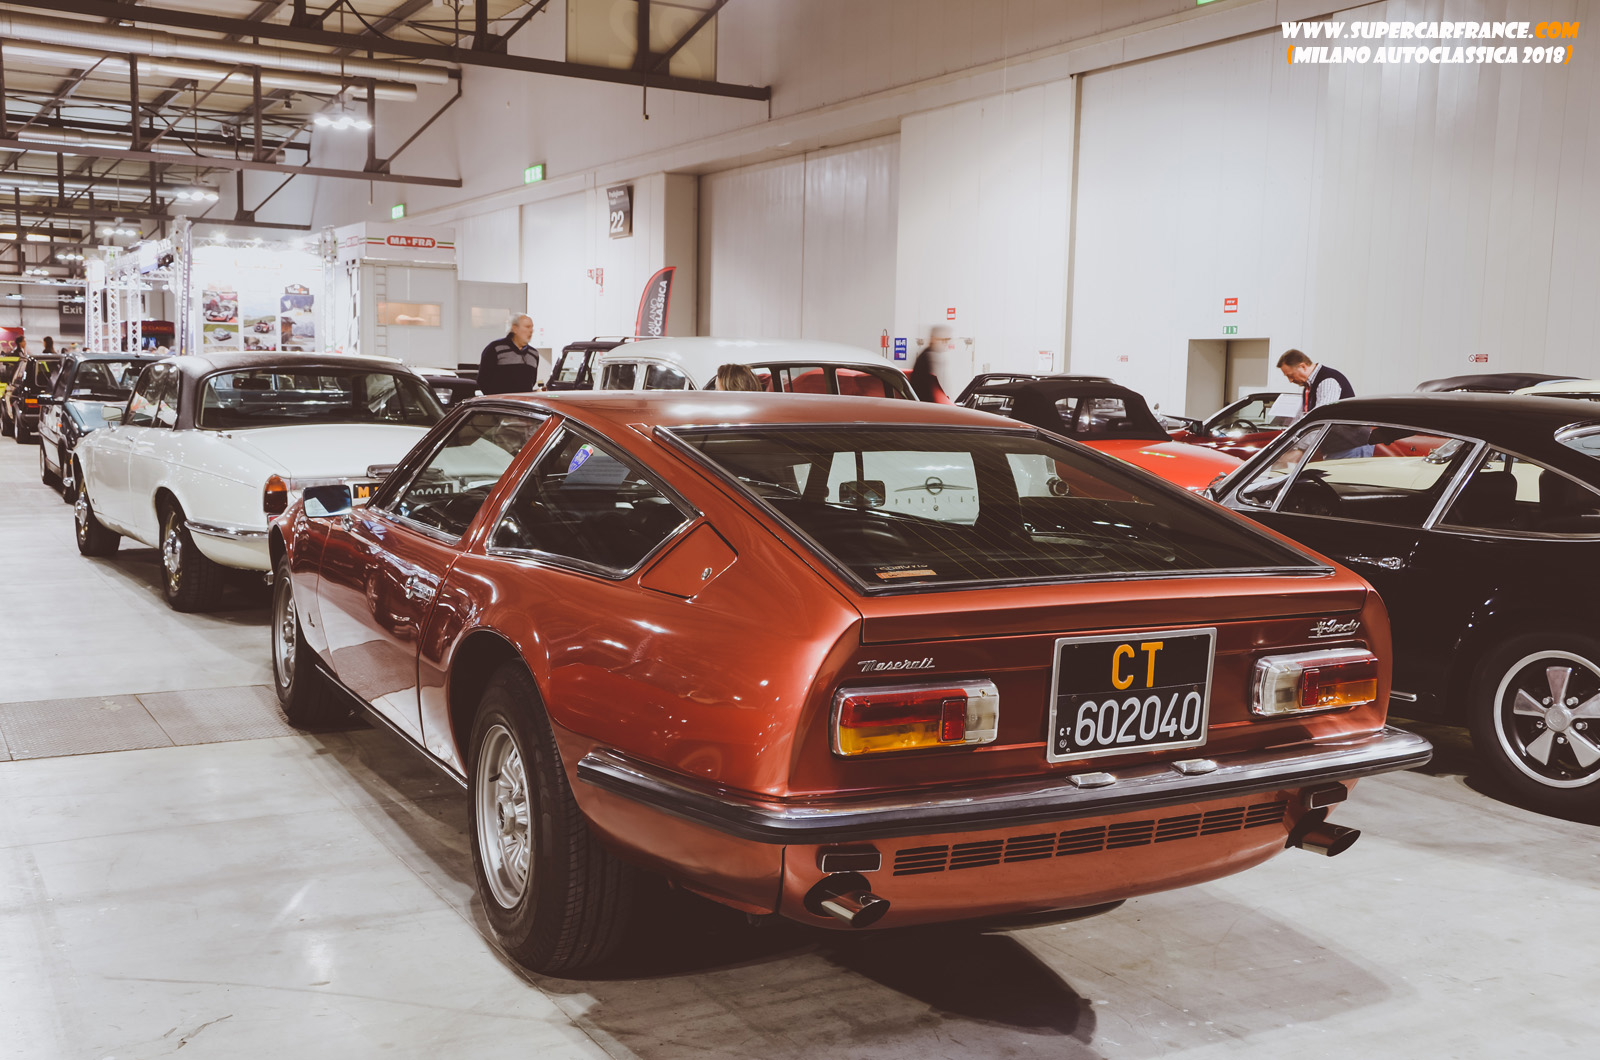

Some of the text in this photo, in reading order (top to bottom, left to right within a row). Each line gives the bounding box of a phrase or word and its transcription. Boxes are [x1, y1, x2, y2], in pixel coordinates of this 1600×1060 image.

[610, 210, 624, 233] 22
[62, 305, 83, 315] Exit
[653, 280, 668, 337] OCLASSICA
[857, 657, 936, 672] Maserati
[1111, 641, 1164, 690] CT
[1075, 691, 1202, 747] 602040
